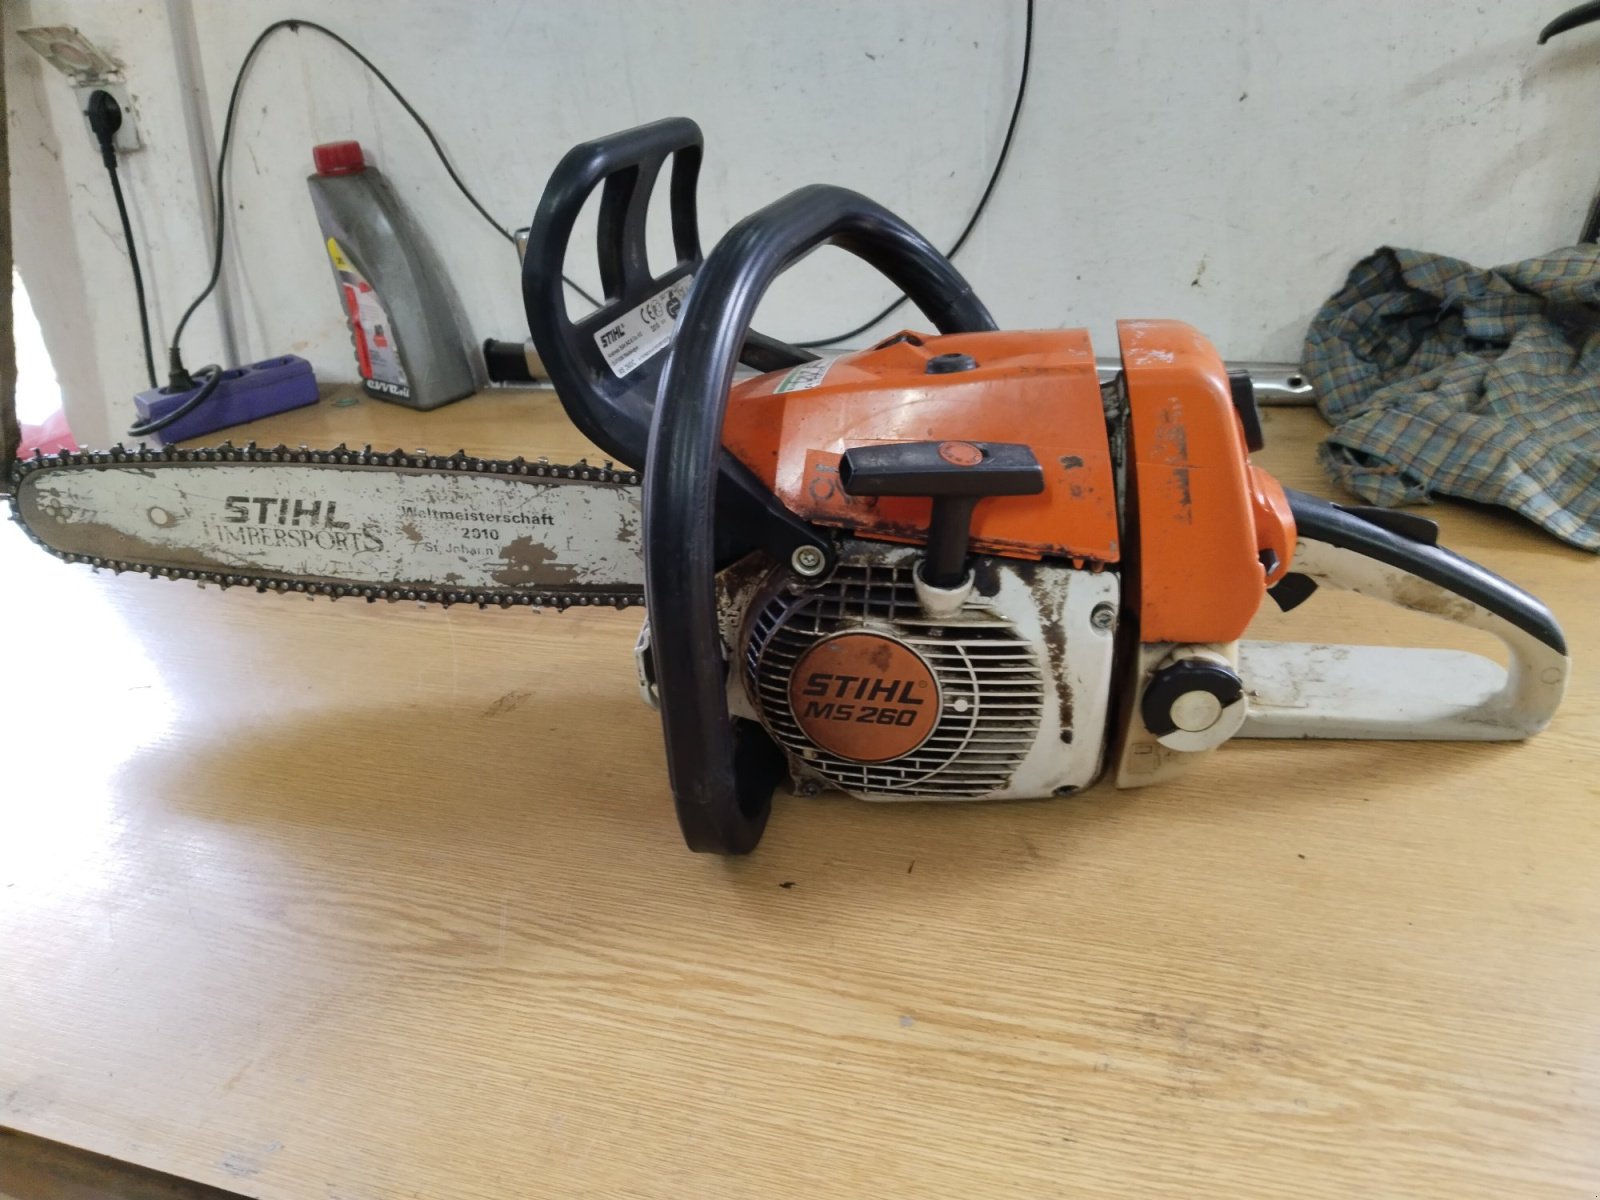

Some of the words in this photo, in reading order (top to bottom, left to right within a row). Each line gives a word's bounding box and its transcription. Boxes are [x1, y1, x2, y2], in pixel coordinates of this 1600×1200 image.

[600, 326, 625, 348] STIHL
[224, 495, 351, 530] STIHL
[401, 506, 555, 526] Weltmeisterschaft
[461, 528, 500, 541] 2010
[802, 673, 924, 705] STIHL
[804, 701, 855, 722] MS
[855, 706, 918, 727] 260
